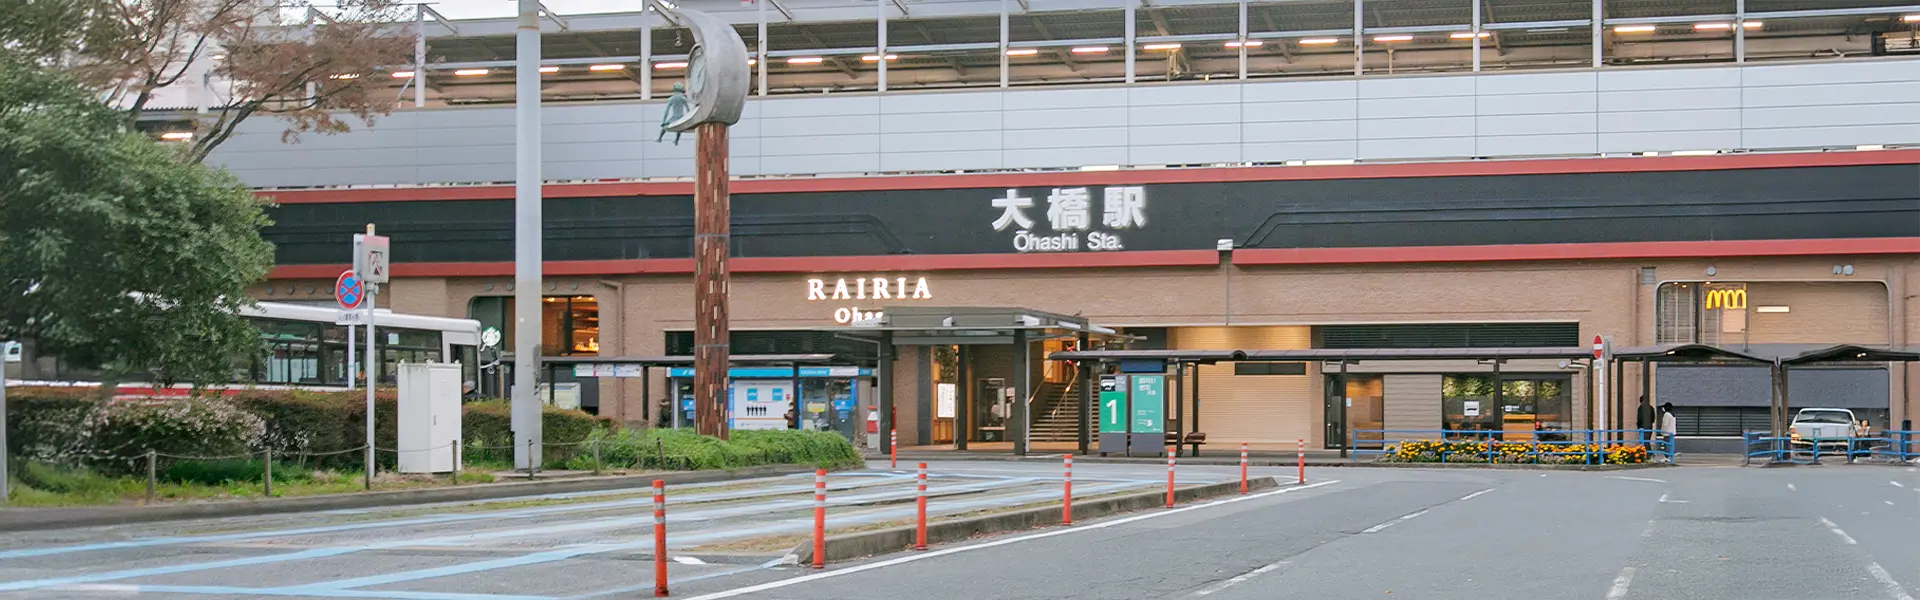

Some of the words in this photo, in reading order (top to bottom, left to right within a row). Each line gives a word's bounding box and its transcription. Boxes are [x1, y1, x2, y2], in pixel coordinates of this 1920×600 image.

[991, 187, 1145, 230] 大橋駅
[1087, 231, 1123, 249] Sta.
[807, 277, 932, 300] RAIRIA
[1106, 399, 1117, 424] 1
